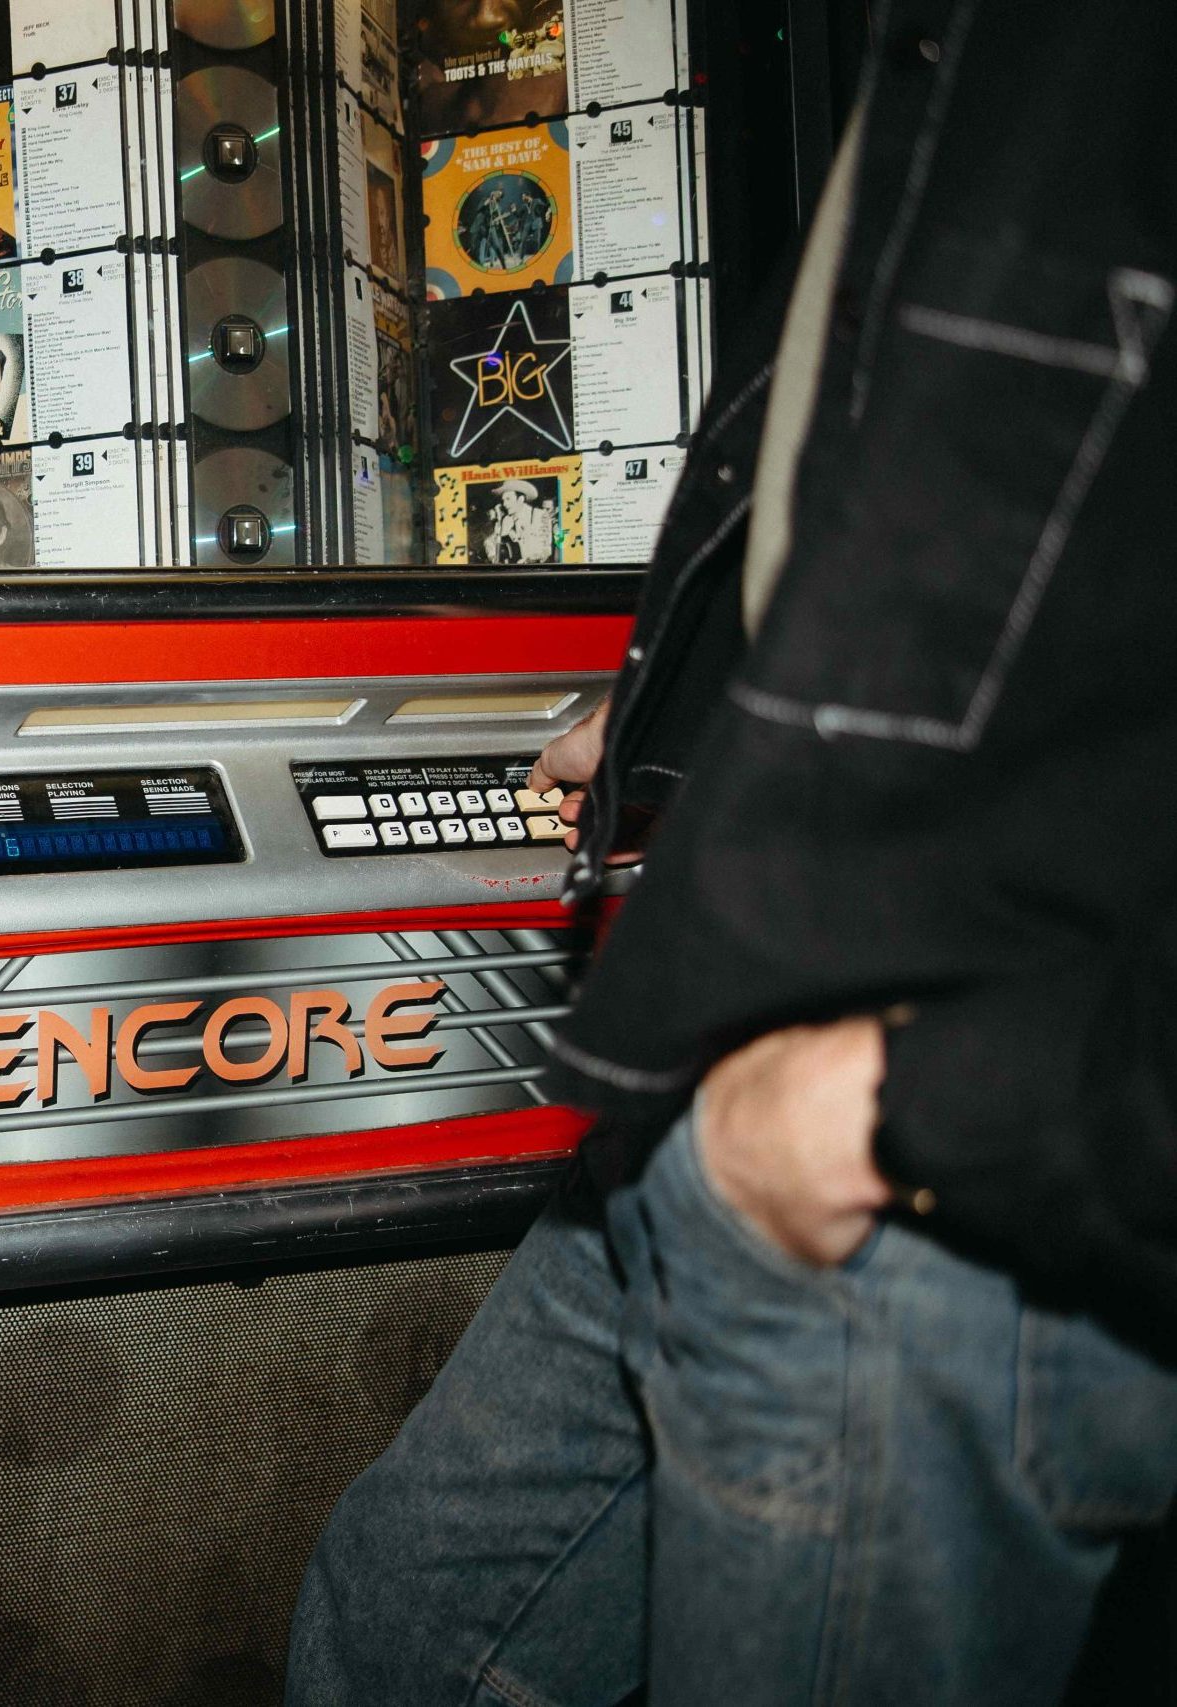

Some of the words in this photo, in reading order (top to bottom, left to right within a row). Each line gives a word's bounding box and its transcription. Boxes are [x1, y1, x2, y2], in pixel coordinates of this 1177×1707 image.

[444, 66, 476, 82] TOOTS
[478, 63, 486, 76] &
[488, 60, 506, 74] THE
[506, 52, 552, 71] MAYTALS
[58, 84, 76, 101] 37
[612, 122, 631, 136] 45
[462, 146, 488, 159] THE
[490, 140, 522, 155] BEST
[524, 136, 541, 150] OF
[463, 156, 491, 172] SAM
[494, 155, 504, 168] &
[508, 150, 542, 166] DAVE
[68, 270, 84, 287] 38
[478, 350, 547, 406] BIG
[75, 454, 94, 471] 39
[462, 468, 502, 482] Hank
[504, 463, 569, 480] Williams
[625, 461, 642, 476] 47
[62, 480, 84, 489] Sturgill
[84, 478, 110, 486] Simpson
[46, 782, 94, 790] SELECTION
[140, 778, 188, 786] SELECTION
[48, 790, 86, 798] PLAYING
[142, 786, 170, 794] BEING
[171, 785, 196, 793] MADE
[380, 798, 390, 808] 0
[410, 796, 418, 806] 1
[438, 796, 450, 805] 2
[467, 795, 478, 804] 3
[497, 794, 508, 803] 4
[390, 826, 402, 836] 5
[420, 826, 432, 834] 6
[448, 824, 460, 832] 7
[478, 822, 490, 832] 8
[508, 822, 519, 830] 9
[6, 838, 20, 857] 6
